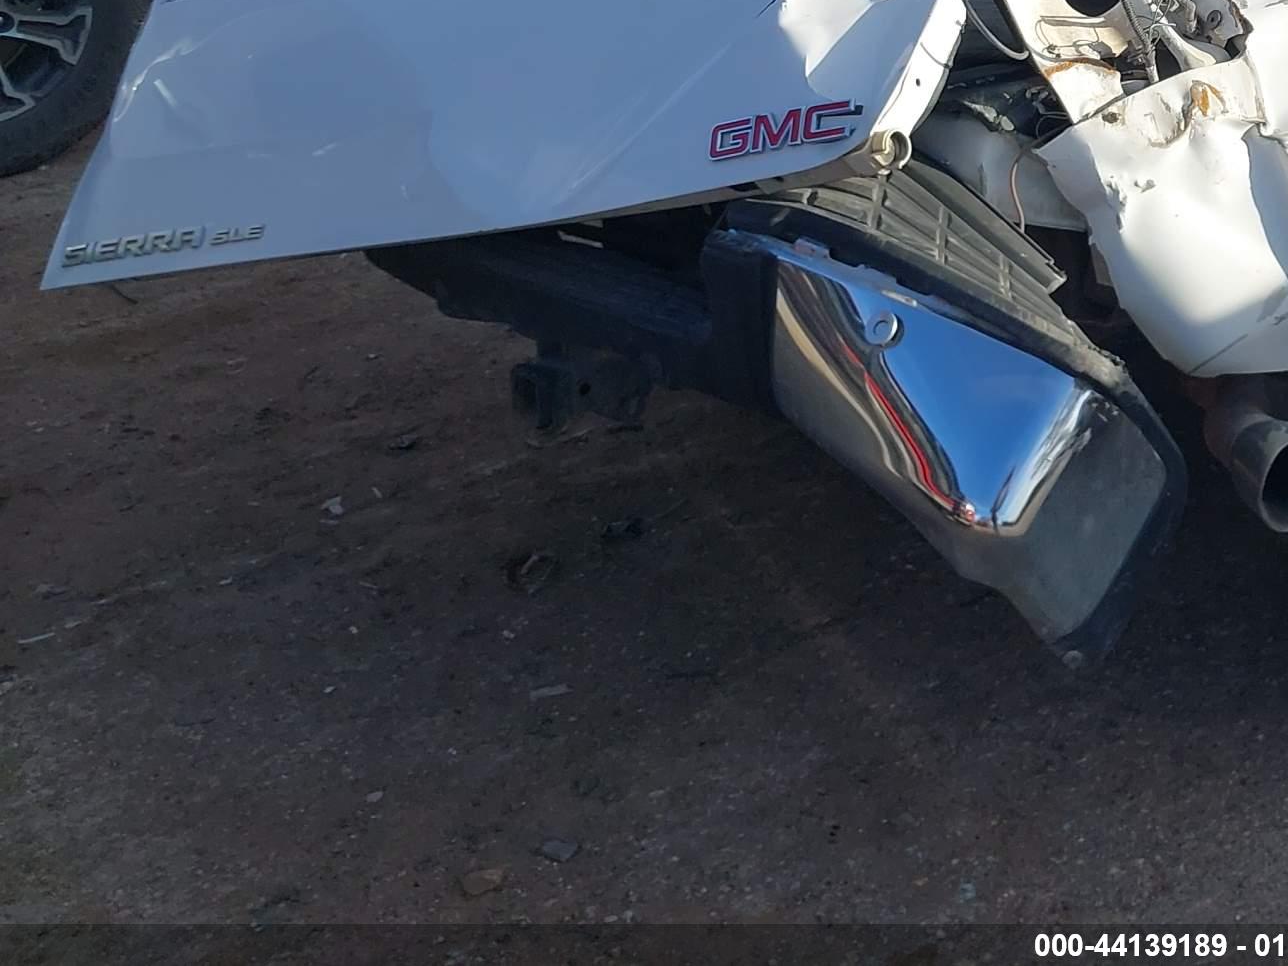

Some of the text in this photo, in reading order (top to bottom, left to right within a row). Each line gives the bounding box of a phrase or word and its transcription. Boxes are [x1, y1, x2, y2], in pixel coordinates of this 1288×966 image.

[708, 97, 863, 162] GMC
[61, 224, 266, 268] SIERRA SLE
